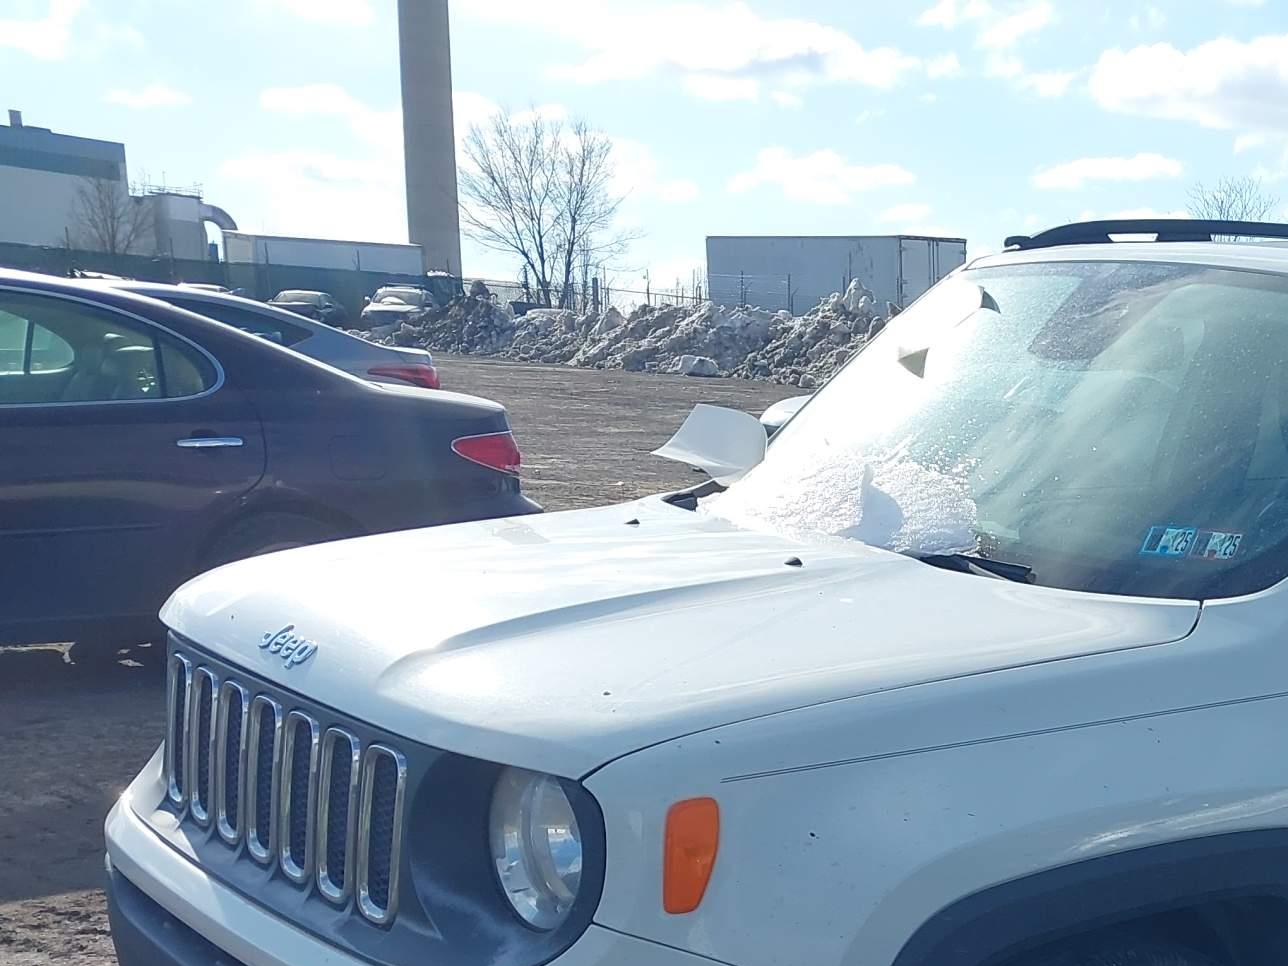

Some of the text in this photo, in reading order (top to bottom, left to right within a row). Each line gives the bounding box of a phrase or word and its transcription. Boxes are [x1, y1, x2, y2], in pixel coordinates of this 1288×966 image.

[1174, 531, 1193, 552] 25
[1223, 535, 1241, 556] 25
[258, 623, 319, 669] Jeep
